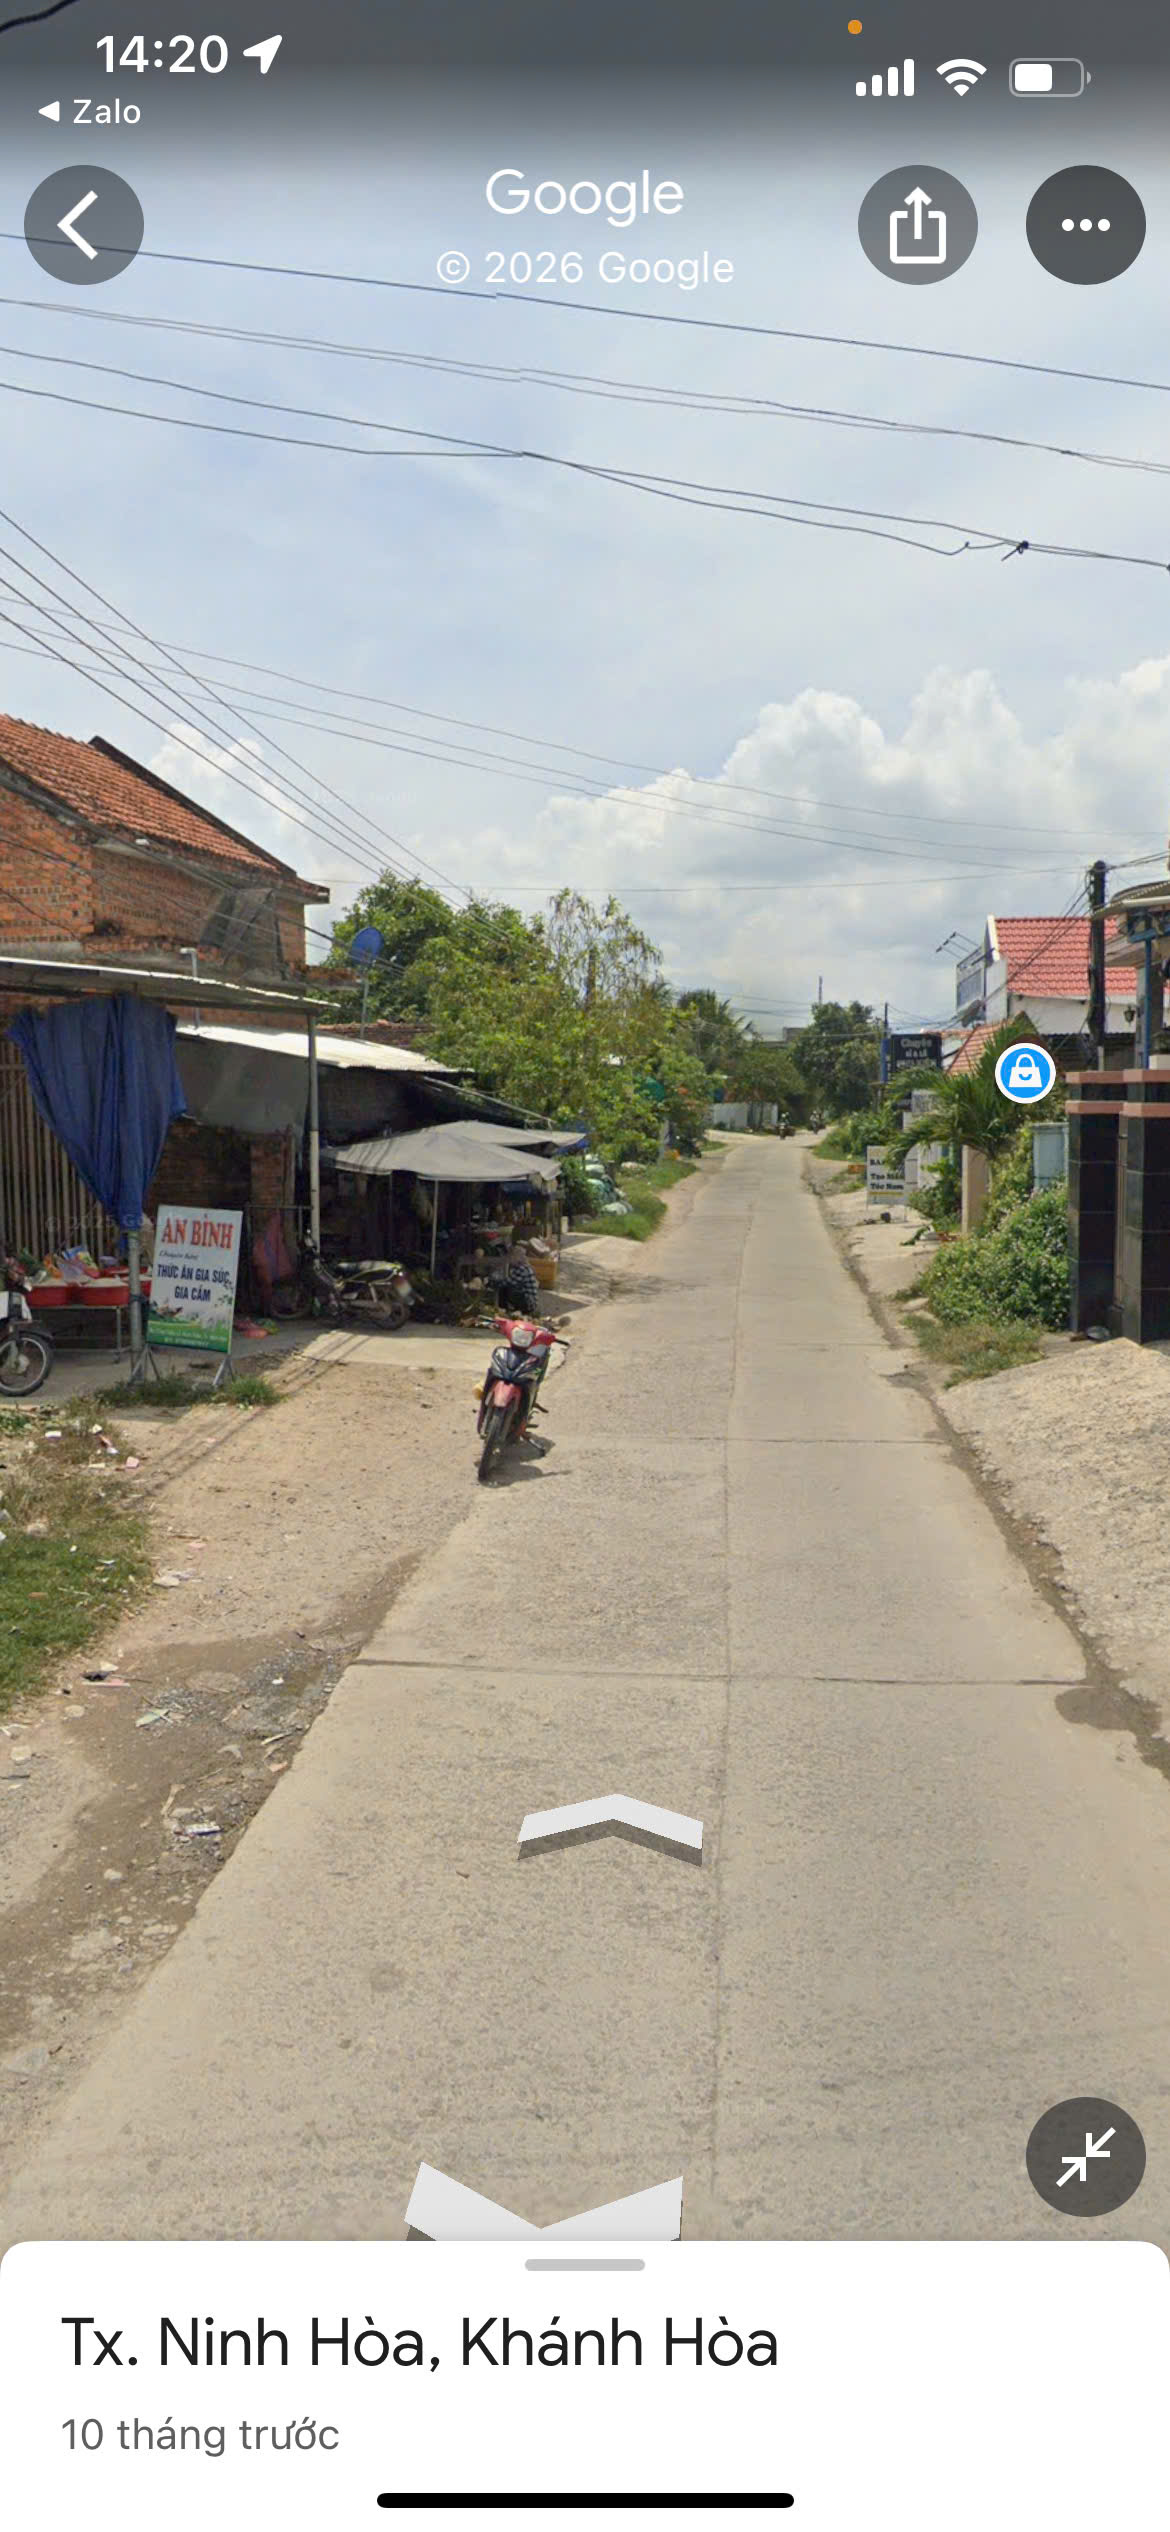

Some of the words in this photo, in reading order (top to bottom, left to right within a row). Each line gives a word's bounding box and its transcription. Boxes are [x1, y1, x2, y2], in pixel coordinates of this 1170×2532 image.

[161, 1217, 188, 1244] AN
[195, 1268, 210, 1282] GIA
[174, 1285, 189, 1300] GIA
